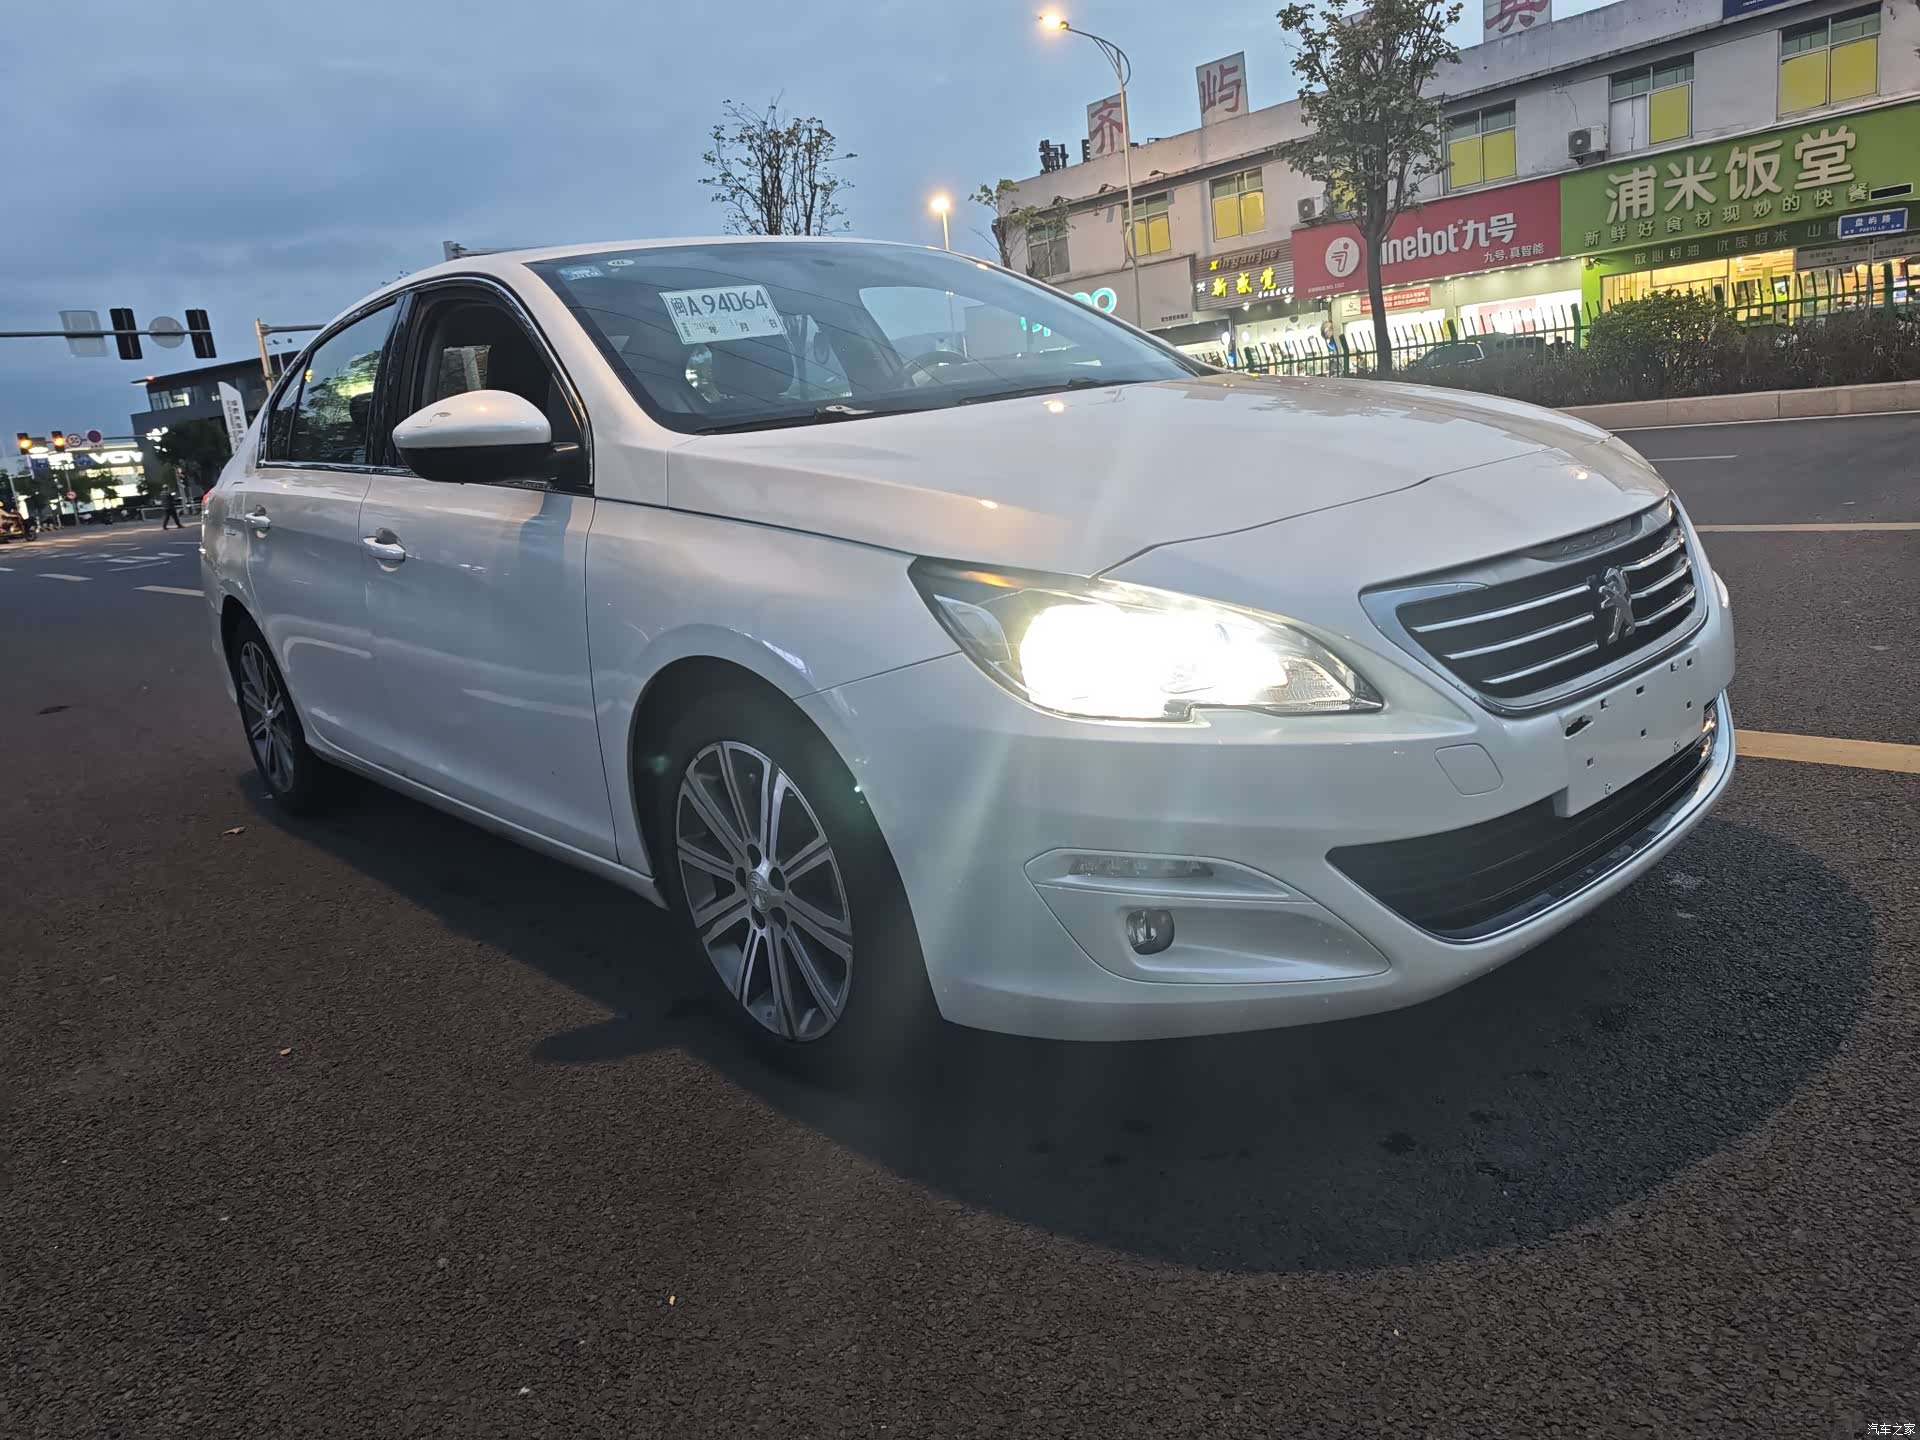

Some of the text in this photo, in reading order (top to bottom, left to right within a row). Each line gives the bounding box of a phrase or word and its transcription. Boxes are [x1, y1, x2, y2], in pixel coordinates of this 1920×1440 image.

[1200, 64, 1241, 114] 屿
[1606, 125, 1856, 224] 浦米饭堂
[1380, 212, 1517, 265] inebot 九号
[1584, 182, 1869, 248] 新鲜好食材现炒的快餐
